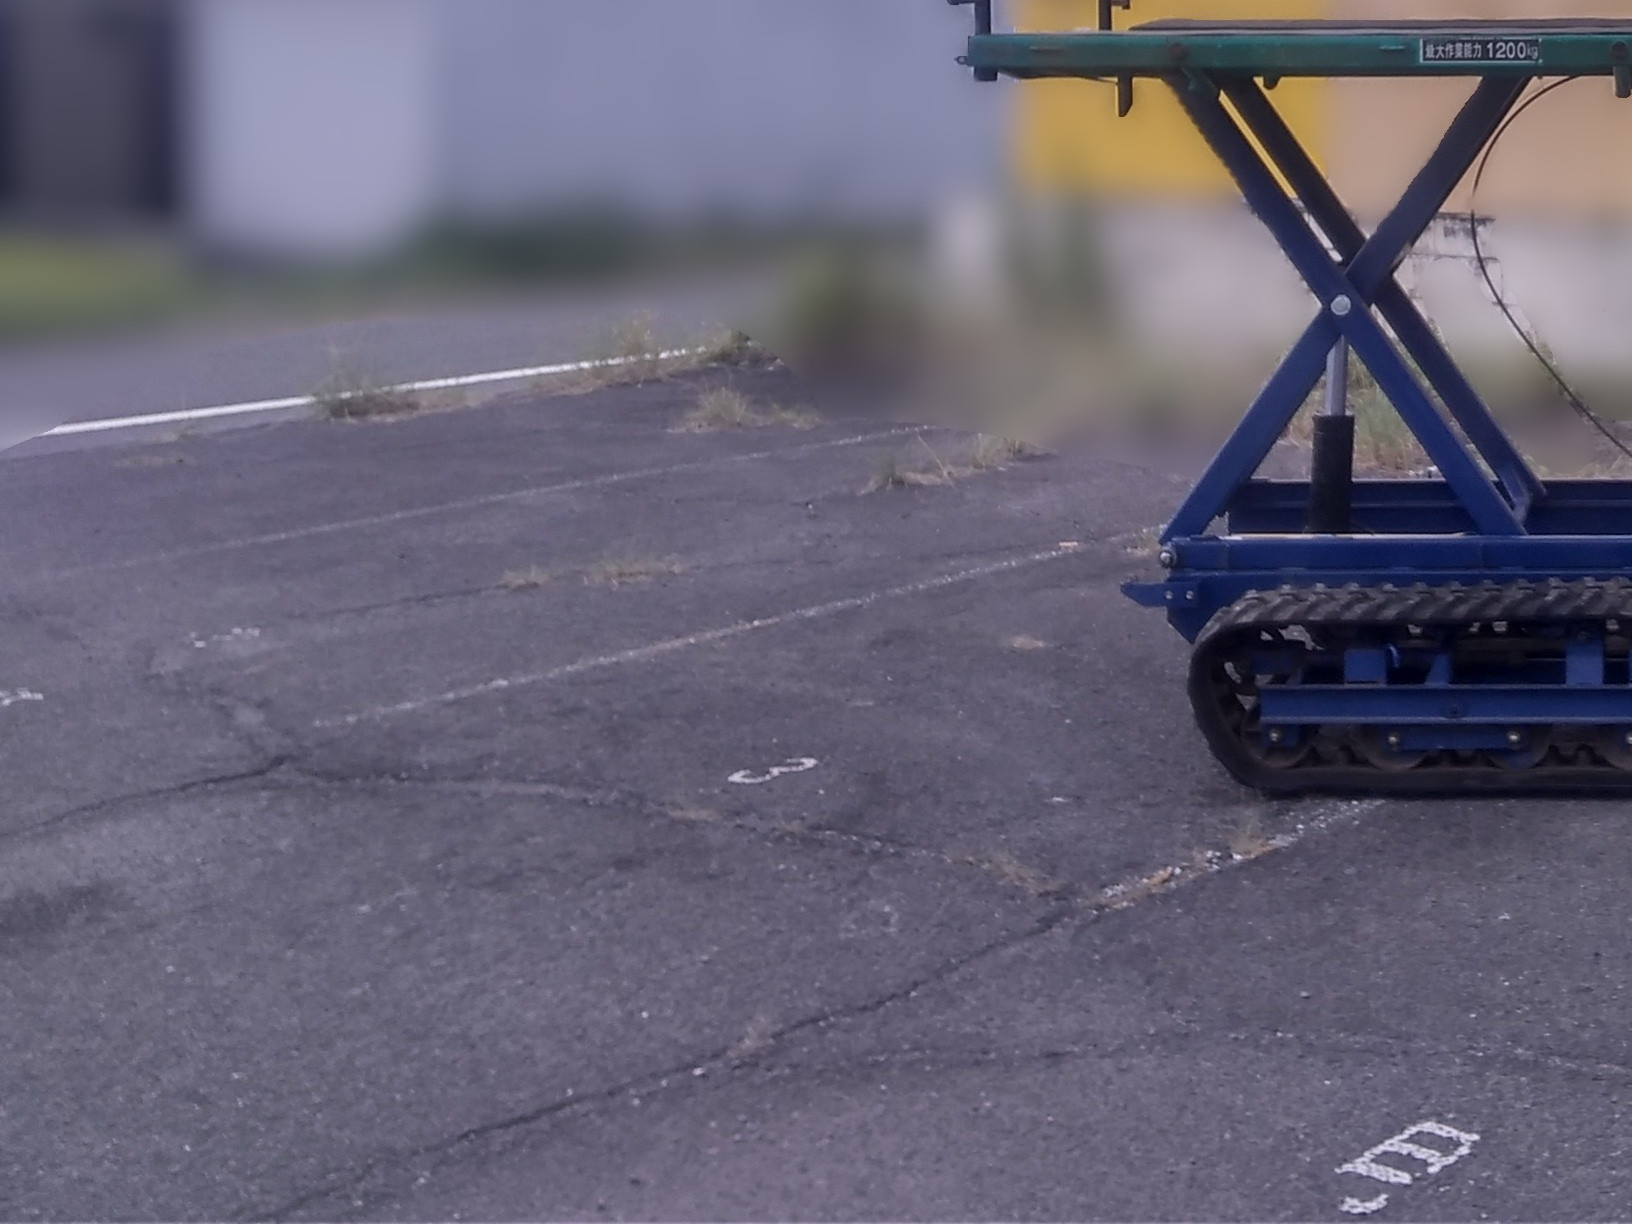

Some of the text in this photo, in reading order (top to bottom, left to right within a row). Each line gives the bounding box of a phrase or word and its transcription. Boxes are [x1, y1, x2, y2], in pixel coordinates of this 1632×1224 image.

[1425, 44, 1482, 59] 最大作業能力
